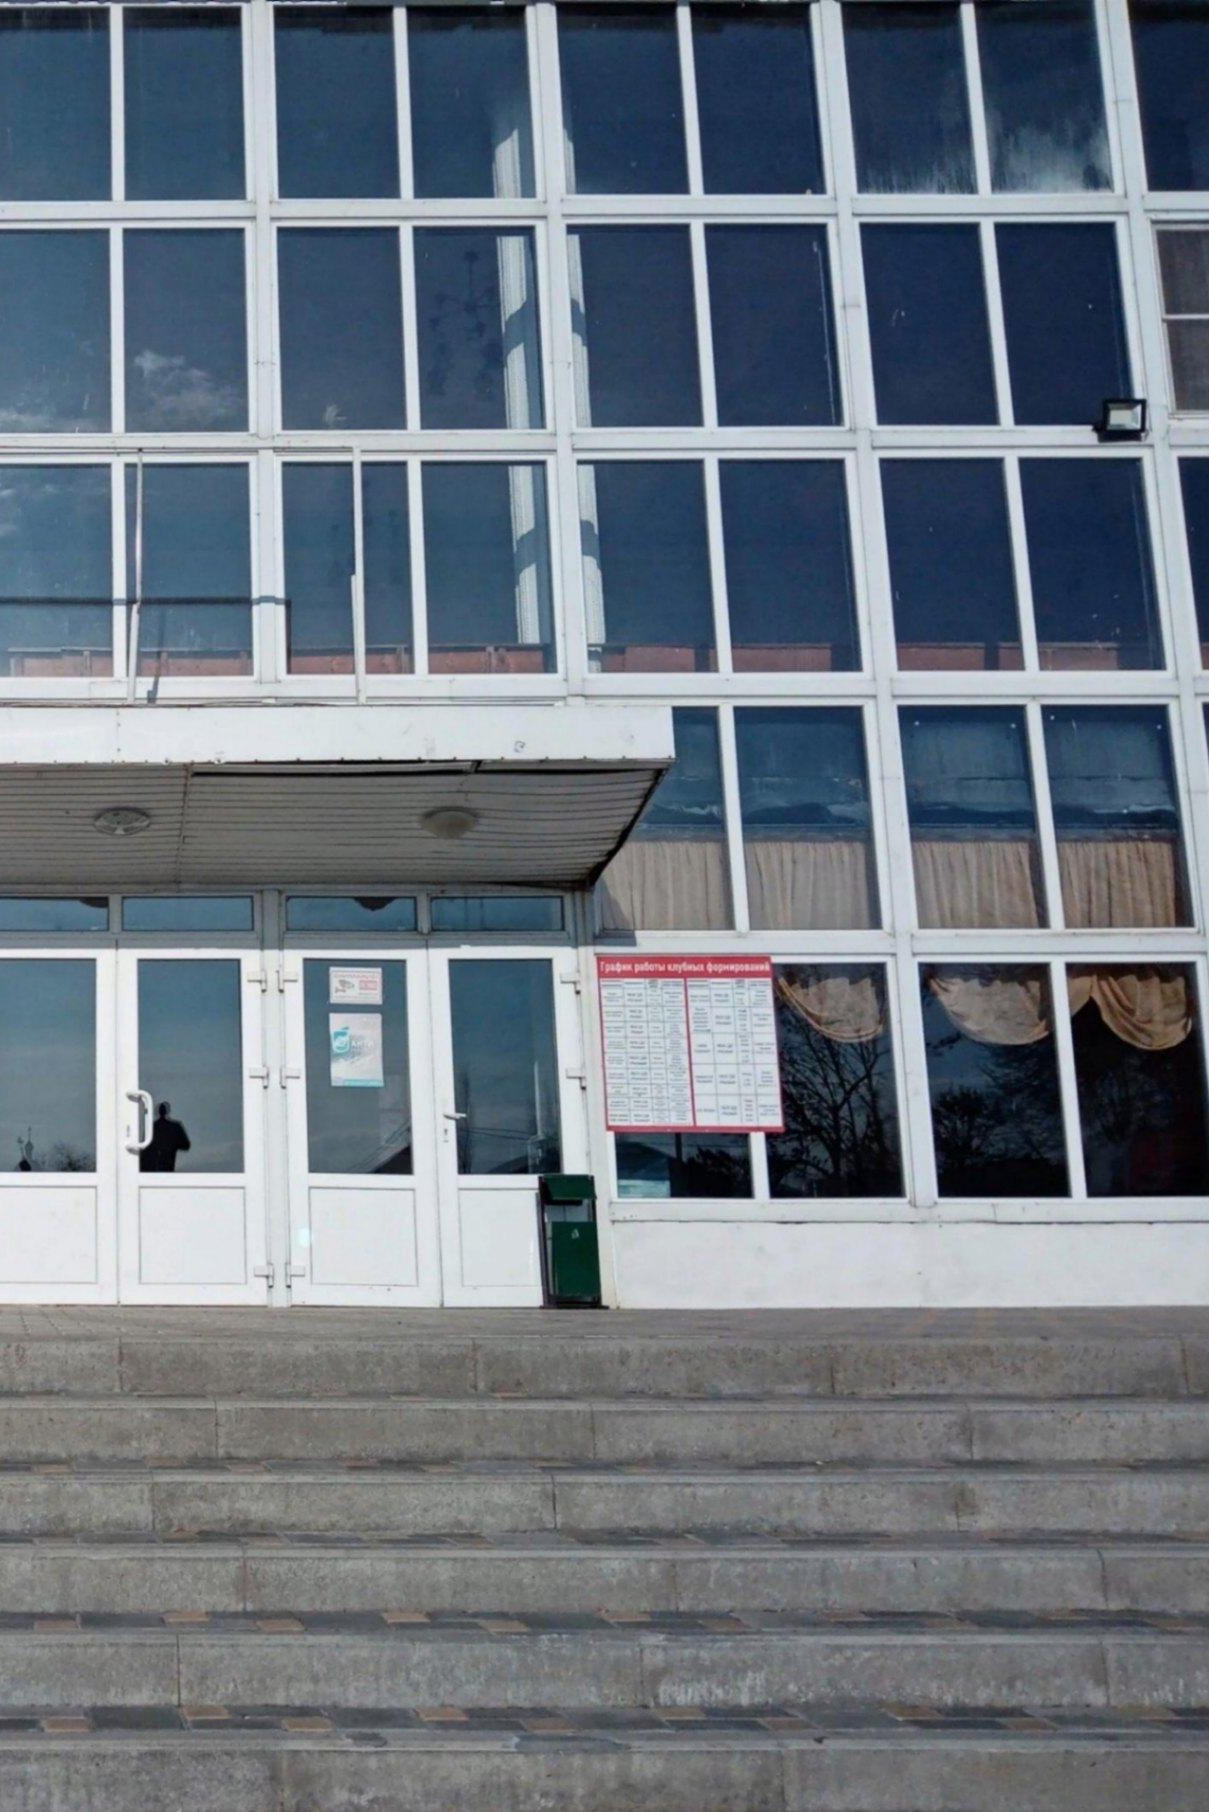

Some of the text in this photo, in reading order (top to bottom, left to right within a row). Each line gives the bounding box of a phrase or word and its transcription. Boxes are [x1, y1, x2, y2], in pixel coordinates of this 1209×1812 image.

[600, 961, 770, 974] График работы клубных формирований
